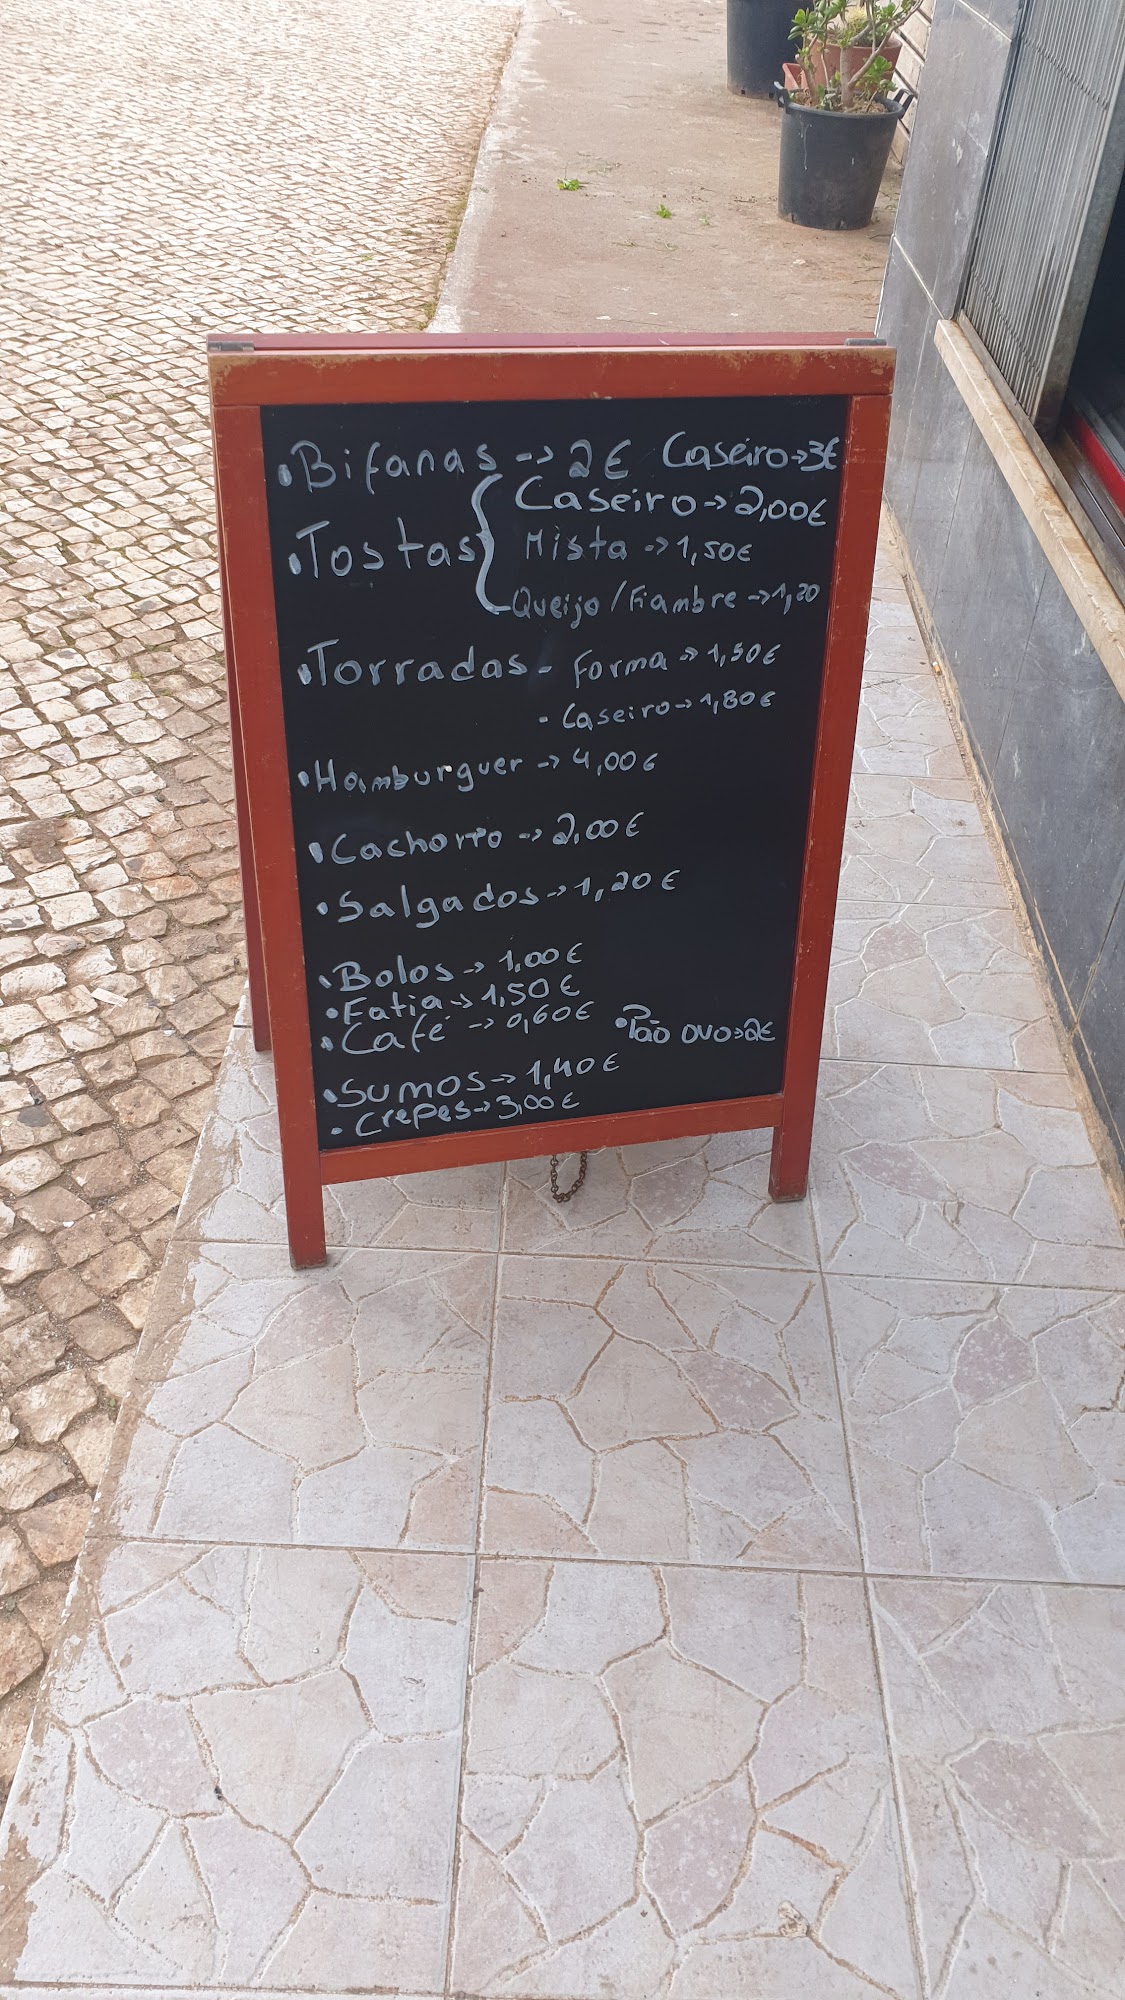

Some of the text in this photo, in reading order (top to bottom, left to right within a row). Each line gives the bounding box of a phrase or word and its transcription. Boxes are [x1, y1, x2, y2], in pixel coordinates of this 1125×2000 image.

[291, 440, 497, 494] Bifanas
[663, 431, 788, 470] Caseiro
[800, 437, 840, 471] 3€
[515, 475, 827, 526] Caseiro 2,00€
[296, 517, 752, 579] Tostas Mista 1,50€
[307, 639, 528, 686] Torradas
[574, 649, 667, 688] Forma
[562, 701, 670, 731] Caseiro
[315, 757, 523, 793] Hamburguer
[331, 827, 502, 864] Cachorro
[337, 883, 540, 928] Salgados
[332, 954, 454, 991] Bolos
[343, 991, 443, 1024] Fatia
[355, 1100, 472, 1137] Crepes
